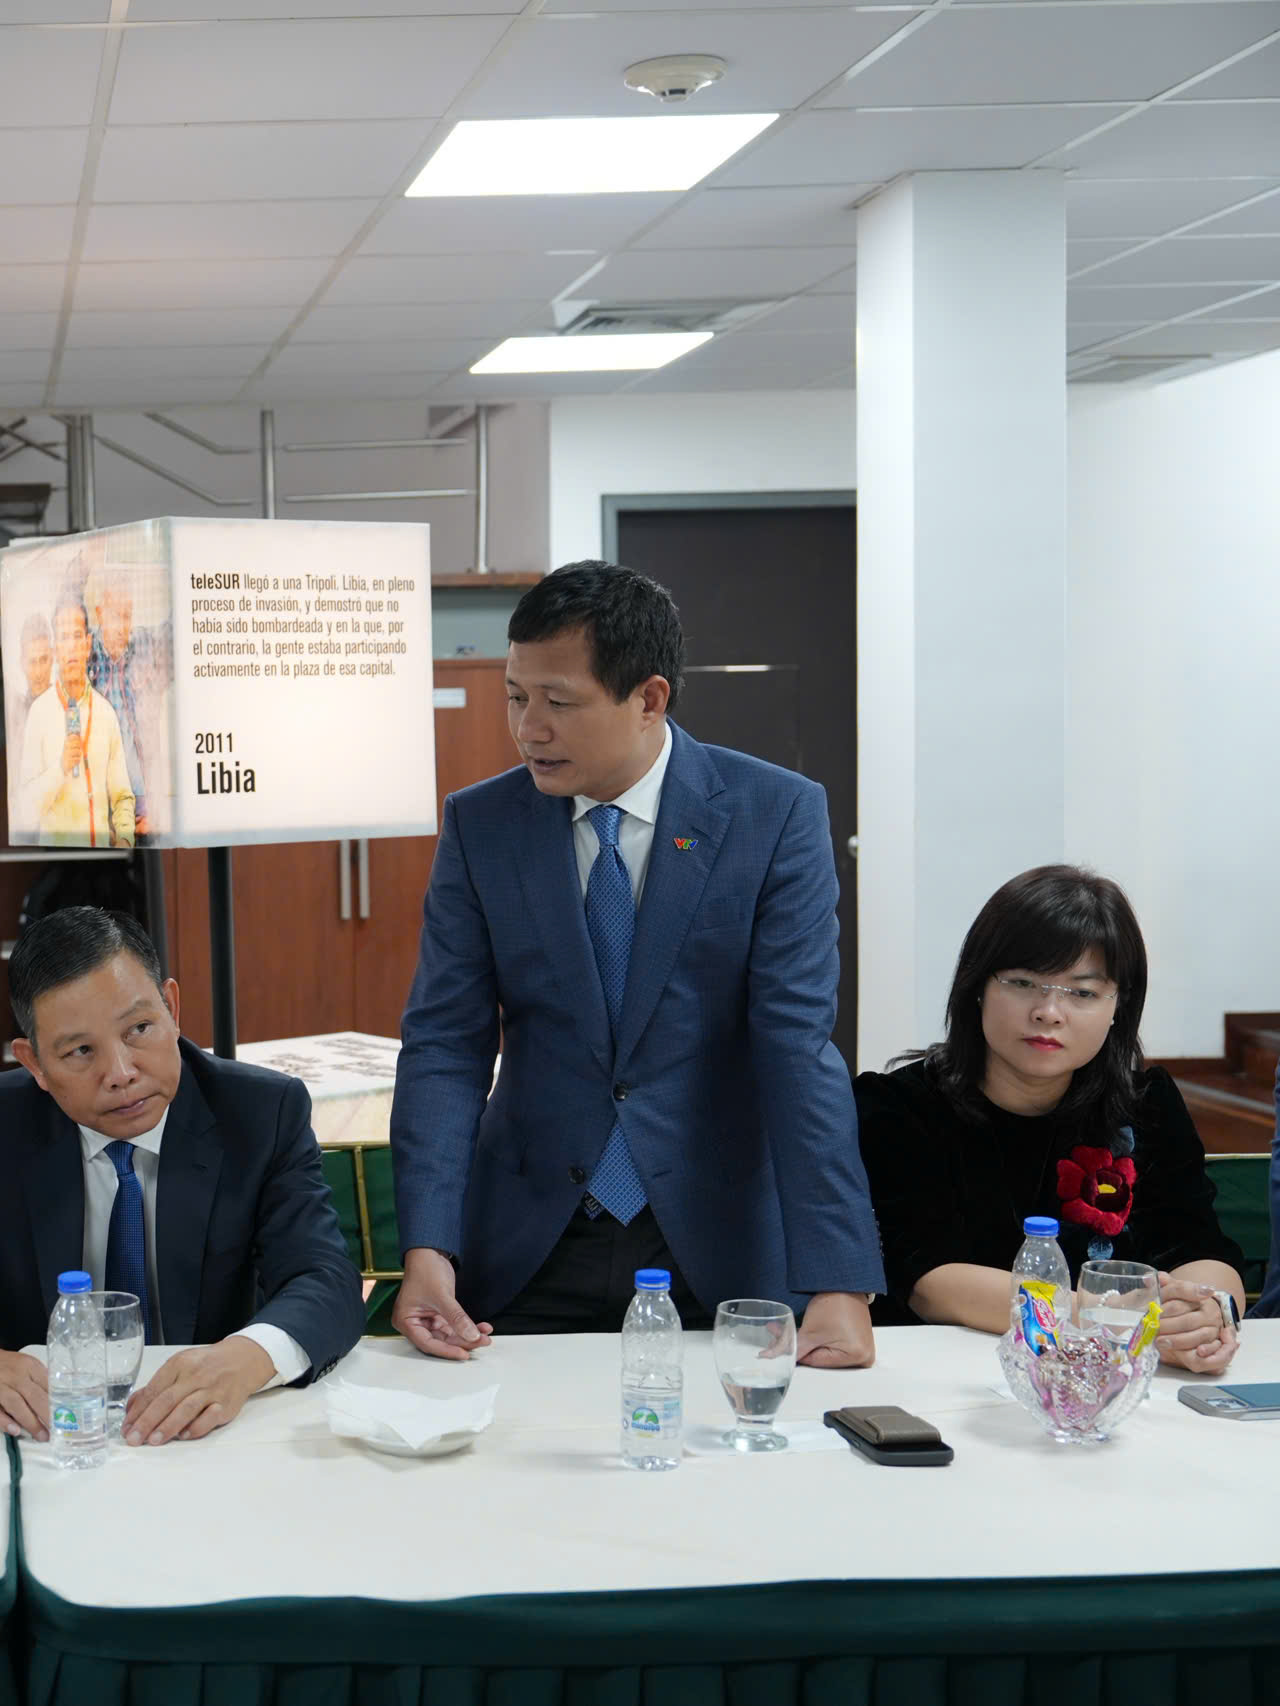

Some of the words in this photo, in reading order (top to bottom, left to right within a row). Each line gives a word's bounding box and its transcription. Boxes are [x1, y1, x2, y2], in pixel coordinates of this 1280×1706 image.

[191, 573, 240, 589] teleSUR
[244, 574, 269, 592] llegó
[273, 579, 279, 590] a
[283, 579, 302, 590] una
[373, 580, 384, 591] en
[388, 576, 415, 593] pleno
[191, 599, 235, 614] proceso
[239, 596, 251, 612] de
[256, 596, 302, 613] invasión,
[305, 599, 311, 615] y
[315, 596, 362, 612] demostró
[366, 599, 384, 614] que
[387, 600, 399, 612] no
[227, 617, 248, 633] sido
[252, 617, 323, 633] bombardeada
[326, 620, 332, 635] y
[336, 620, 348, 633] en
[352, 617, 360, 633] la
[364, 620, 385, 635] que,
[388, 620, 404, 635] por
[193, 639, 202, 655] el
[206, 640, 259, 657] contrario,
[262, 639, 271, 654] la
[275, 640, 304, 657] gente
[308, 639, 341, 654] estaba
[345, 639, 407, 656] participando
[193, 661, 261, 677] activamente
[265, 665, 277, 676] en
[281, 660, 290, 676] la
[293, 660, 320, 679] plaza
[323, 659, 336, 676] de
[339, 663, 356, 676] esa
[360, 660, 396, 677] capital.
[195, 732, 233, 754] 2011
[196, 761, 256, 795] Libia
